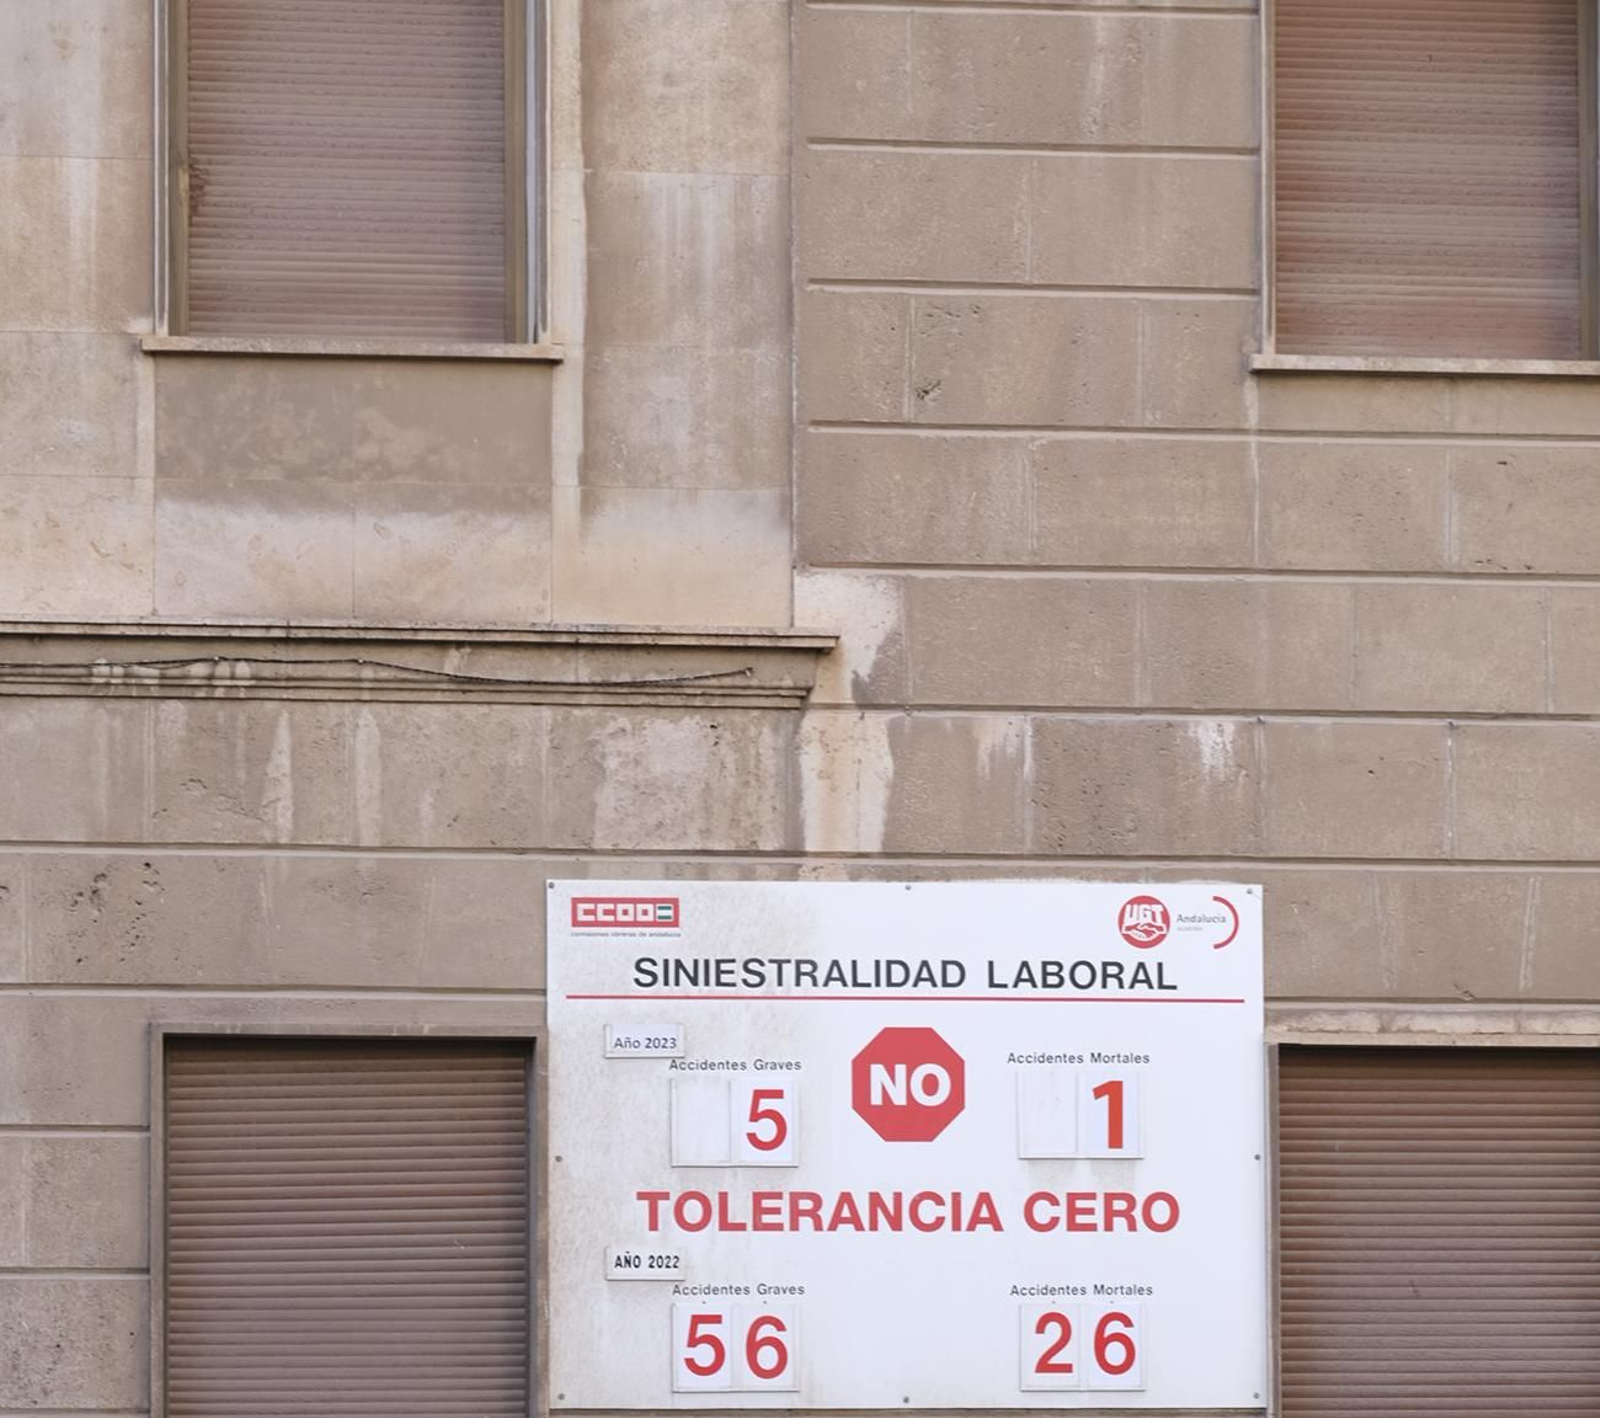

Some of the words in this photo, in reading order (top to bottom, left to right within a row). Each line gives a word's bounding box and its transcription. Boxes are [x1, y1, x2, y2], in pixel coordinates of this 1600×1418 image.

[1123, 903, 1164, 926] UGT
[633, 957, 966, 989] SINIESTRALIDAD
[988, 960, 1178, 991] LABORAL
[613, 1036, 641, 1050] Año
[644, 1037, 677, 1050] 2023
[669, 1058, 747, 1071] Accidentes
[753, 1058, 802, 1071] Graves
[1007, 1052, 1084, 1064] Accidentes
[1090, 1052, 1150, 1064] Mortales
[870, 1063, 951, 1107] NO
[746, 1088, 788, 1151] 5
[1092, 1080, 1124, 1149] 1
[636, 1190, 1004, 1233] TOLERANCIA
[1023, 1190, 1180, 1233] CERO
[614, 1251, 642, 1269] AÑO
[648, 1254, 680, 1269] 2022
[672, 1283, 751, 1296] Accidentes
[756, 1283, 805, 1296] Graves
[1010, 1284, 1087, 1297] Accidentes
[1093, 1284, 1153, 1297] Mortales
